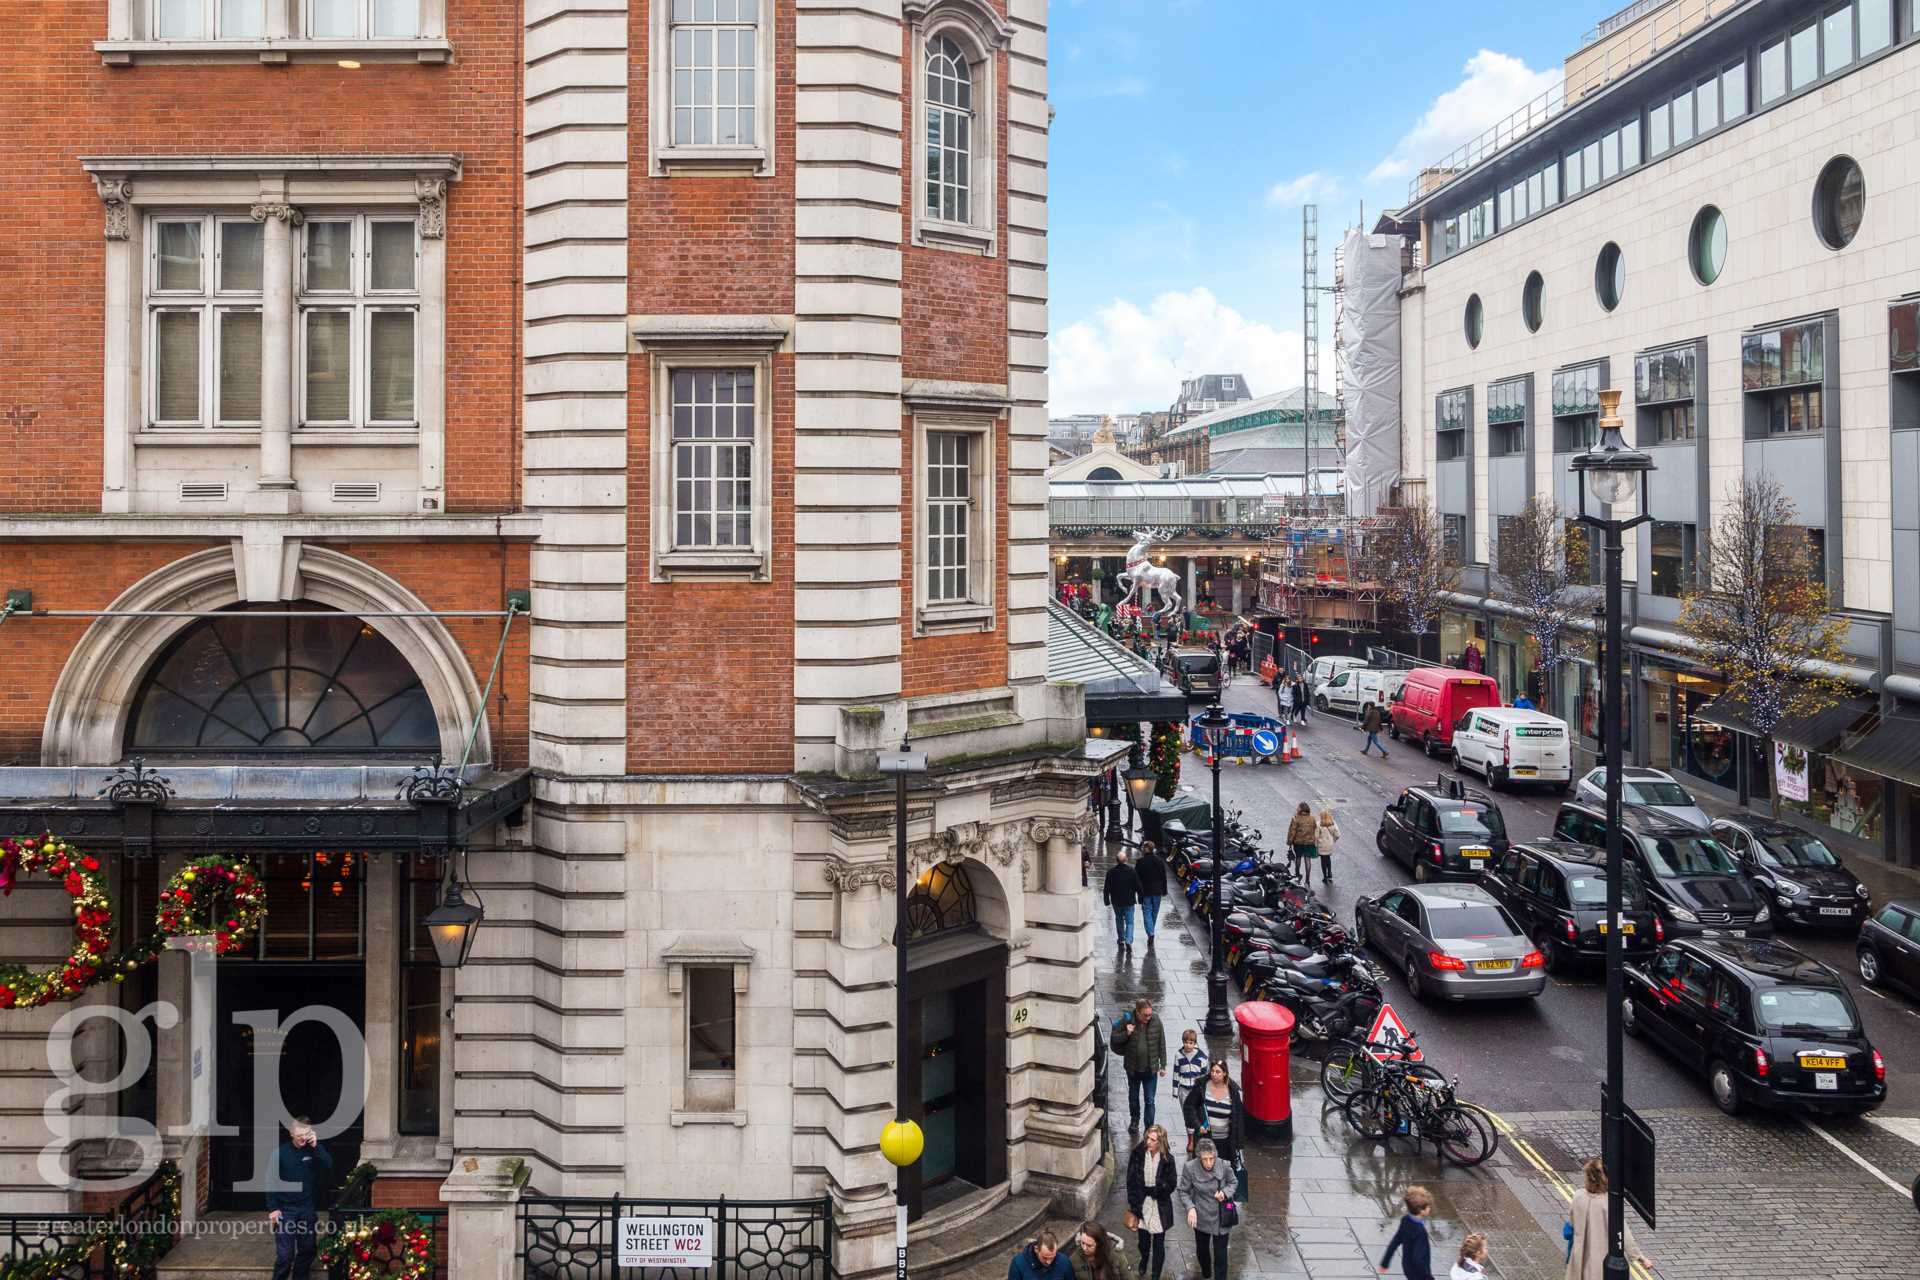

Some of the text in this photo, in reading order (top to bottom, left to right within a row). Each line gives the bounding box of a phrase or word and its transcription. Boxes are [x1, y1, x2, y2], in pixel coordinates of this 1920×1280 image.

[1516, 727, 1562, 737] enterprise
[1014, 1008, 1028, 1023] 49
[1806, 1058, 1840, 1067] KE14 VFF
[626, 1223, 704, 1236] WELLINGTON
[625, 1238, 701, 1251] STREET WC2
